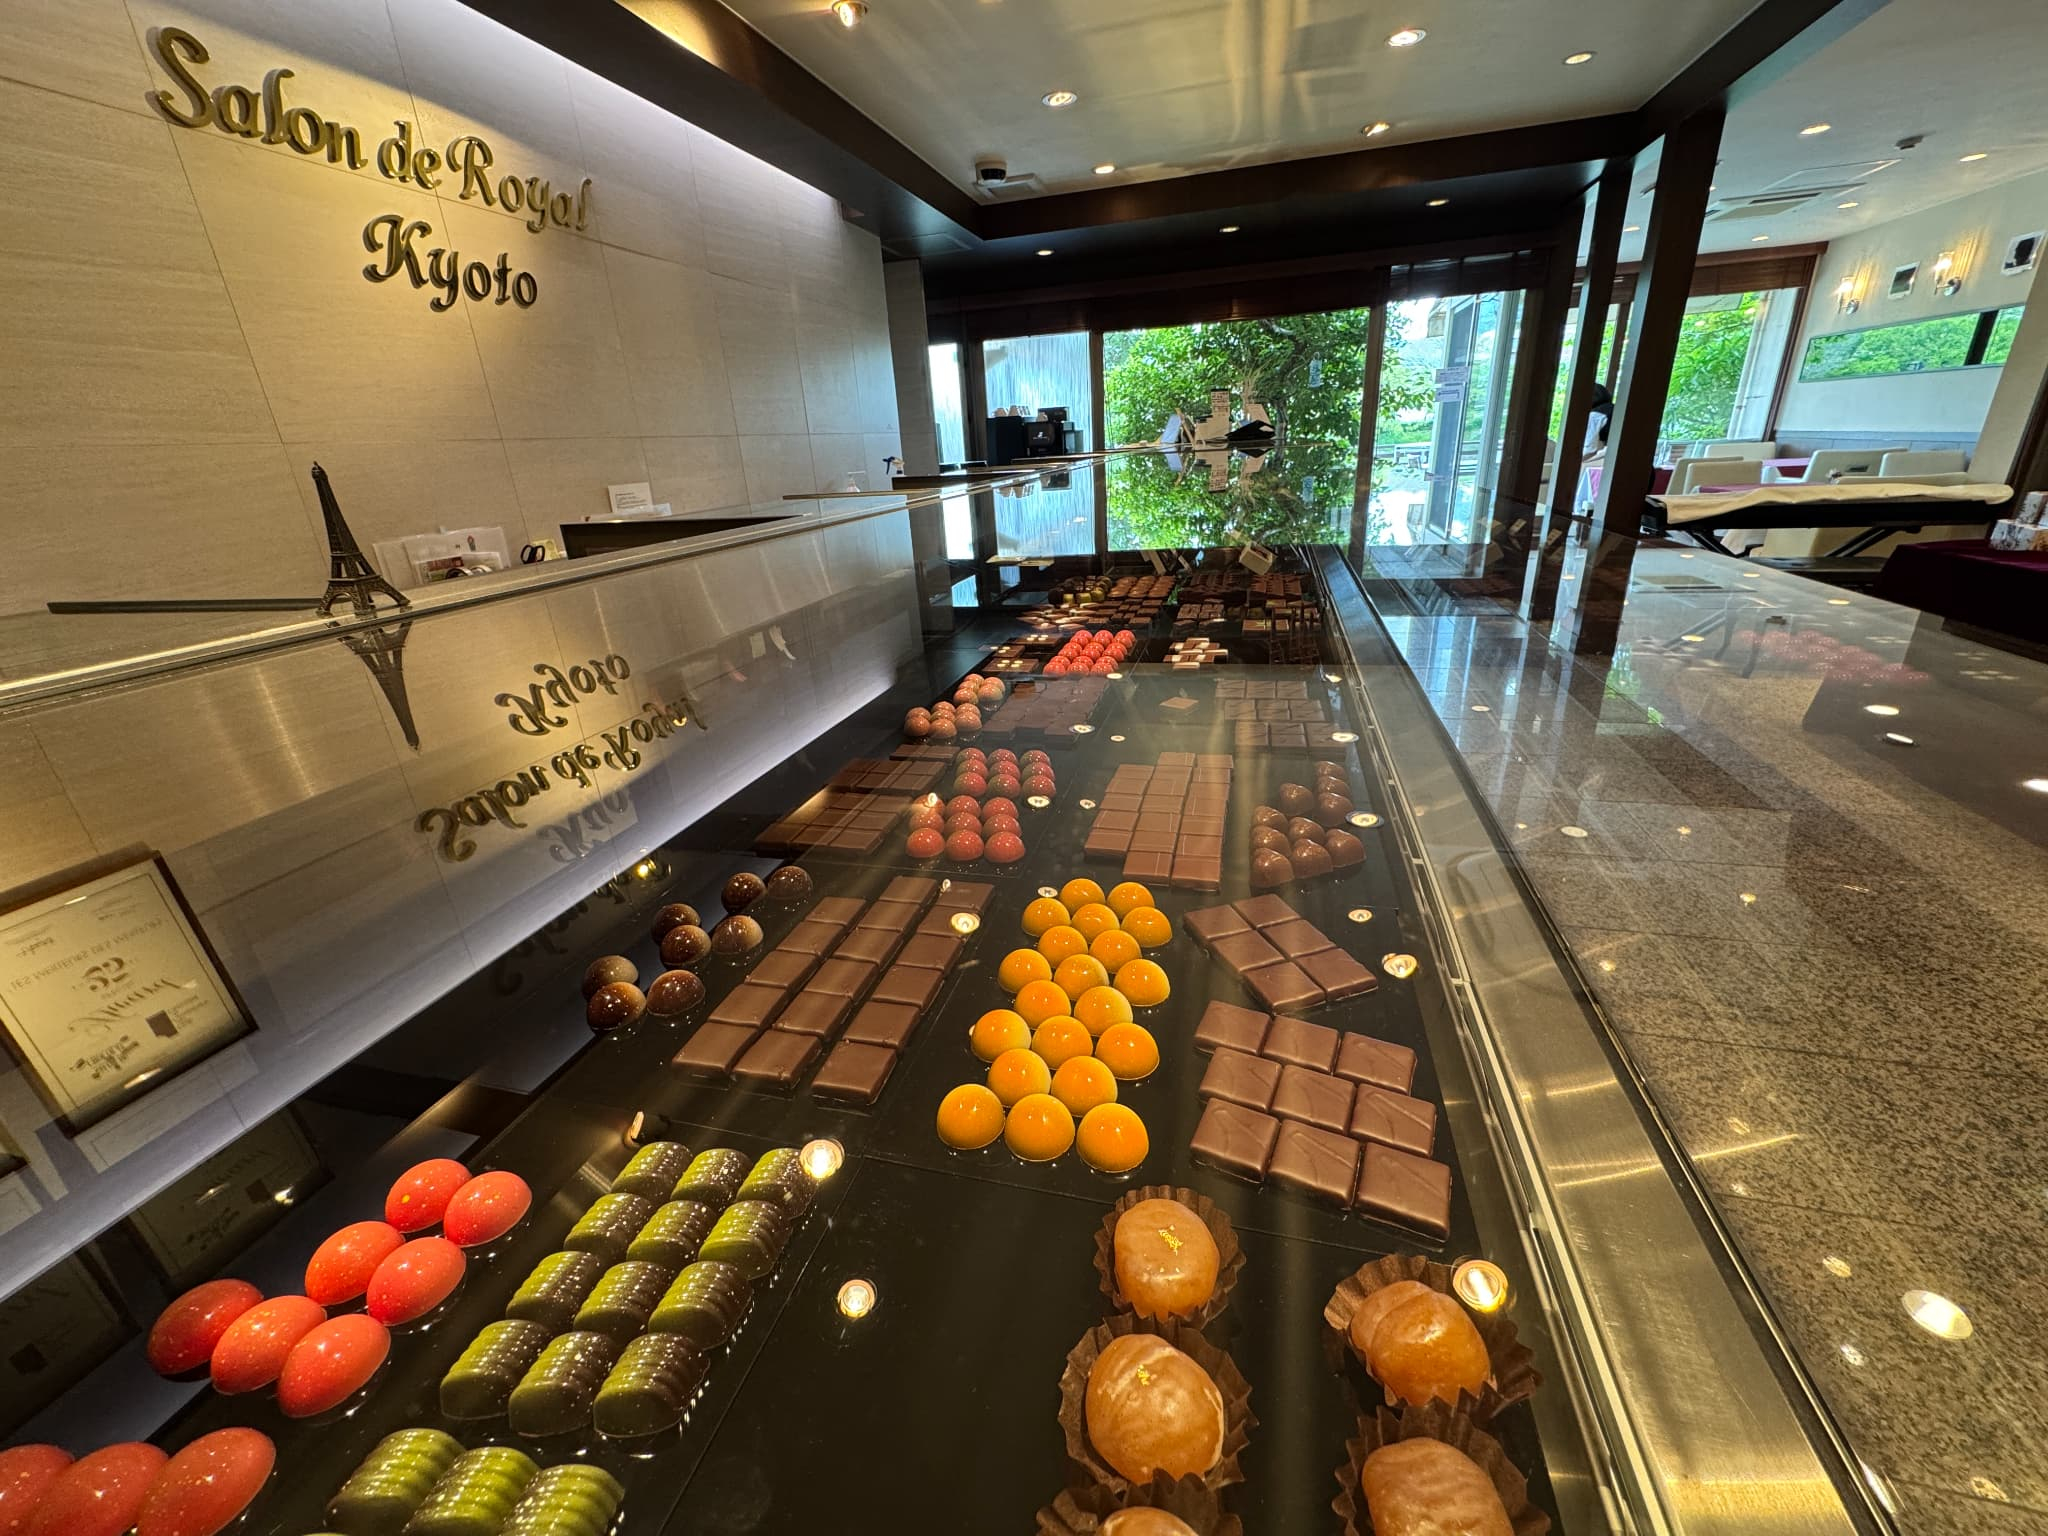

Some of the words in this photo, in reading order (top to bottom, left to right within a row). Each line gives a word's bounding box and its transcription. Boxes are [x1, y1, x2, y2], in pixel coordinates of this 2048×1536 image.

[146, 26, 367, 171] Salon
[377, 120, 441, 190] de
[447, 135, 592, 233] Royal
[362, 213, 538, 313] Kyoto
